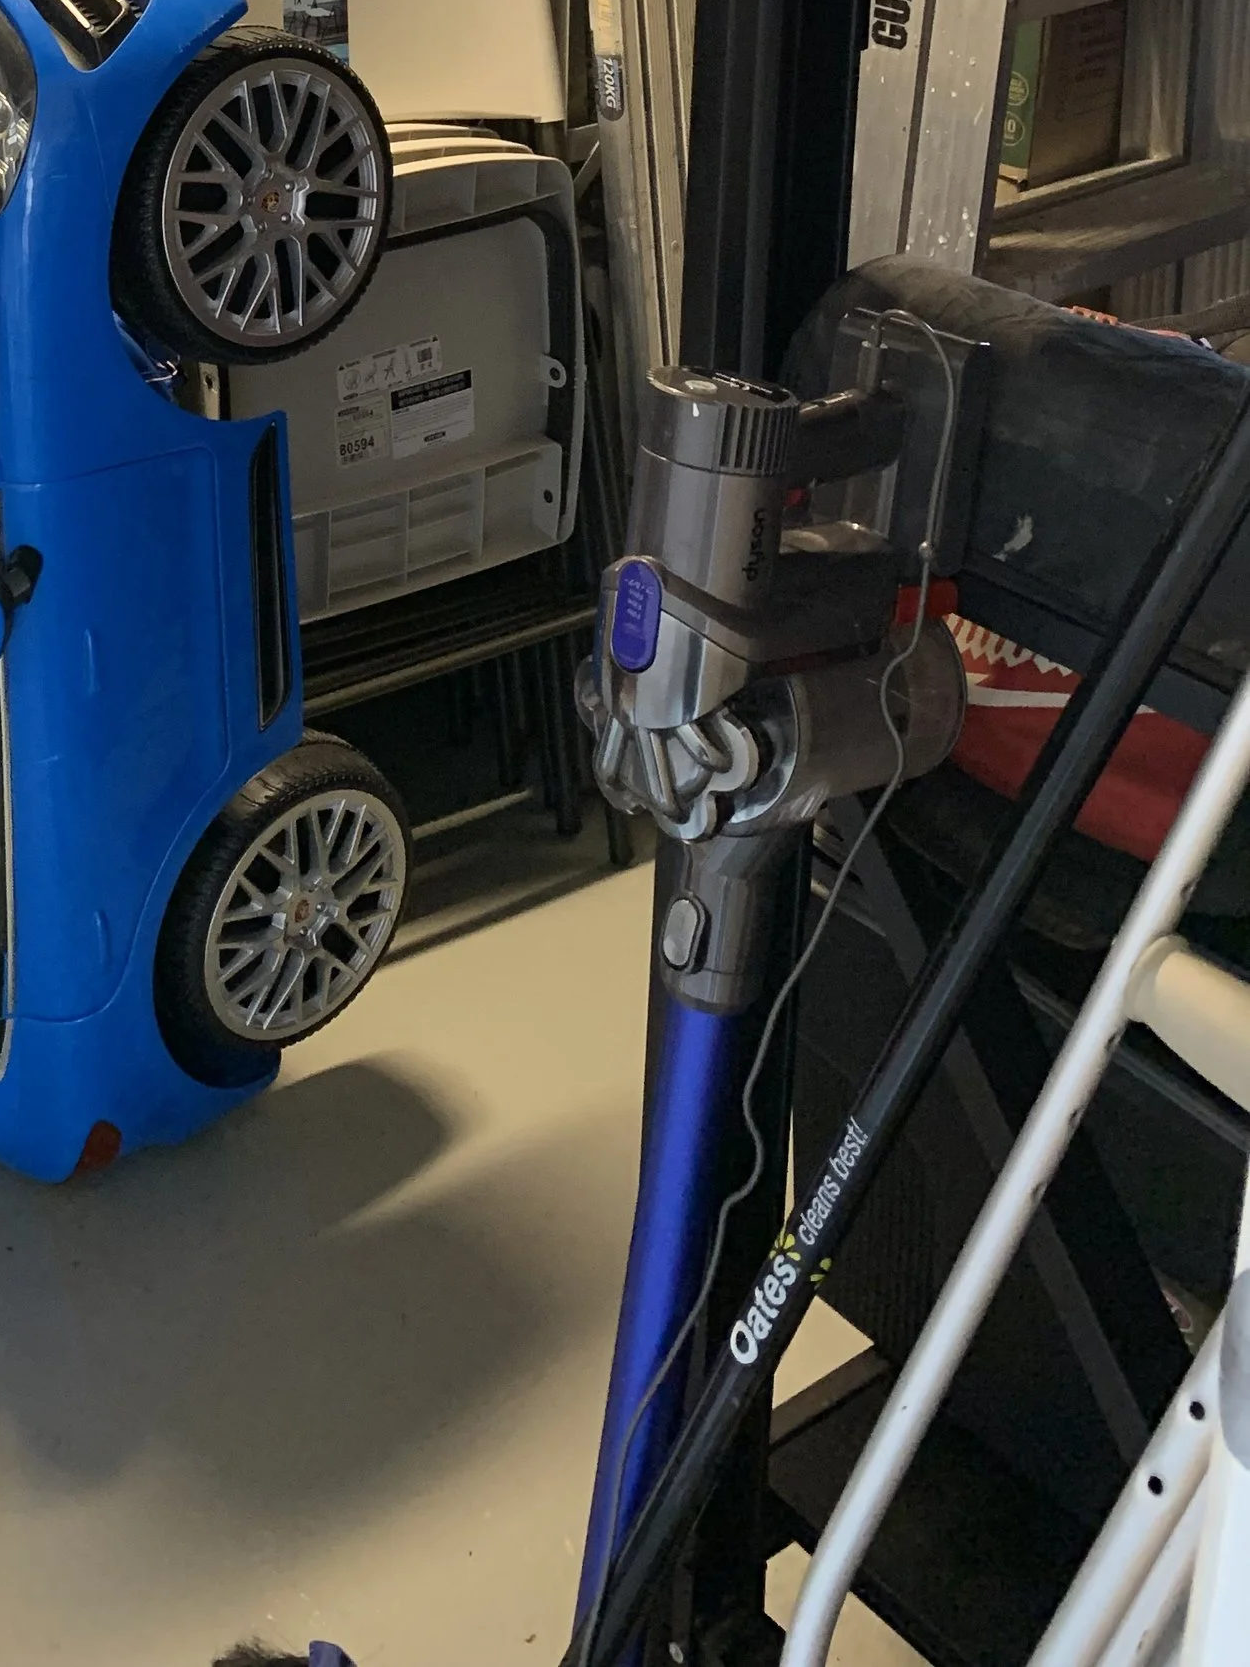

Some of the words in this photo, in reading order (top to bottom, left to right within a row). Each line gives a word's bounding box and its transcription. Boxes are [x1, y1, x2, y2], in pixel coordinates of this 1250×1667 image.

[603, 56, 617, 110] 120KG
[798, 1175, 842, 1246] cleans
[829, 1115, 870, 1181] best!
[730, 1254, 798, 1365] Oates
